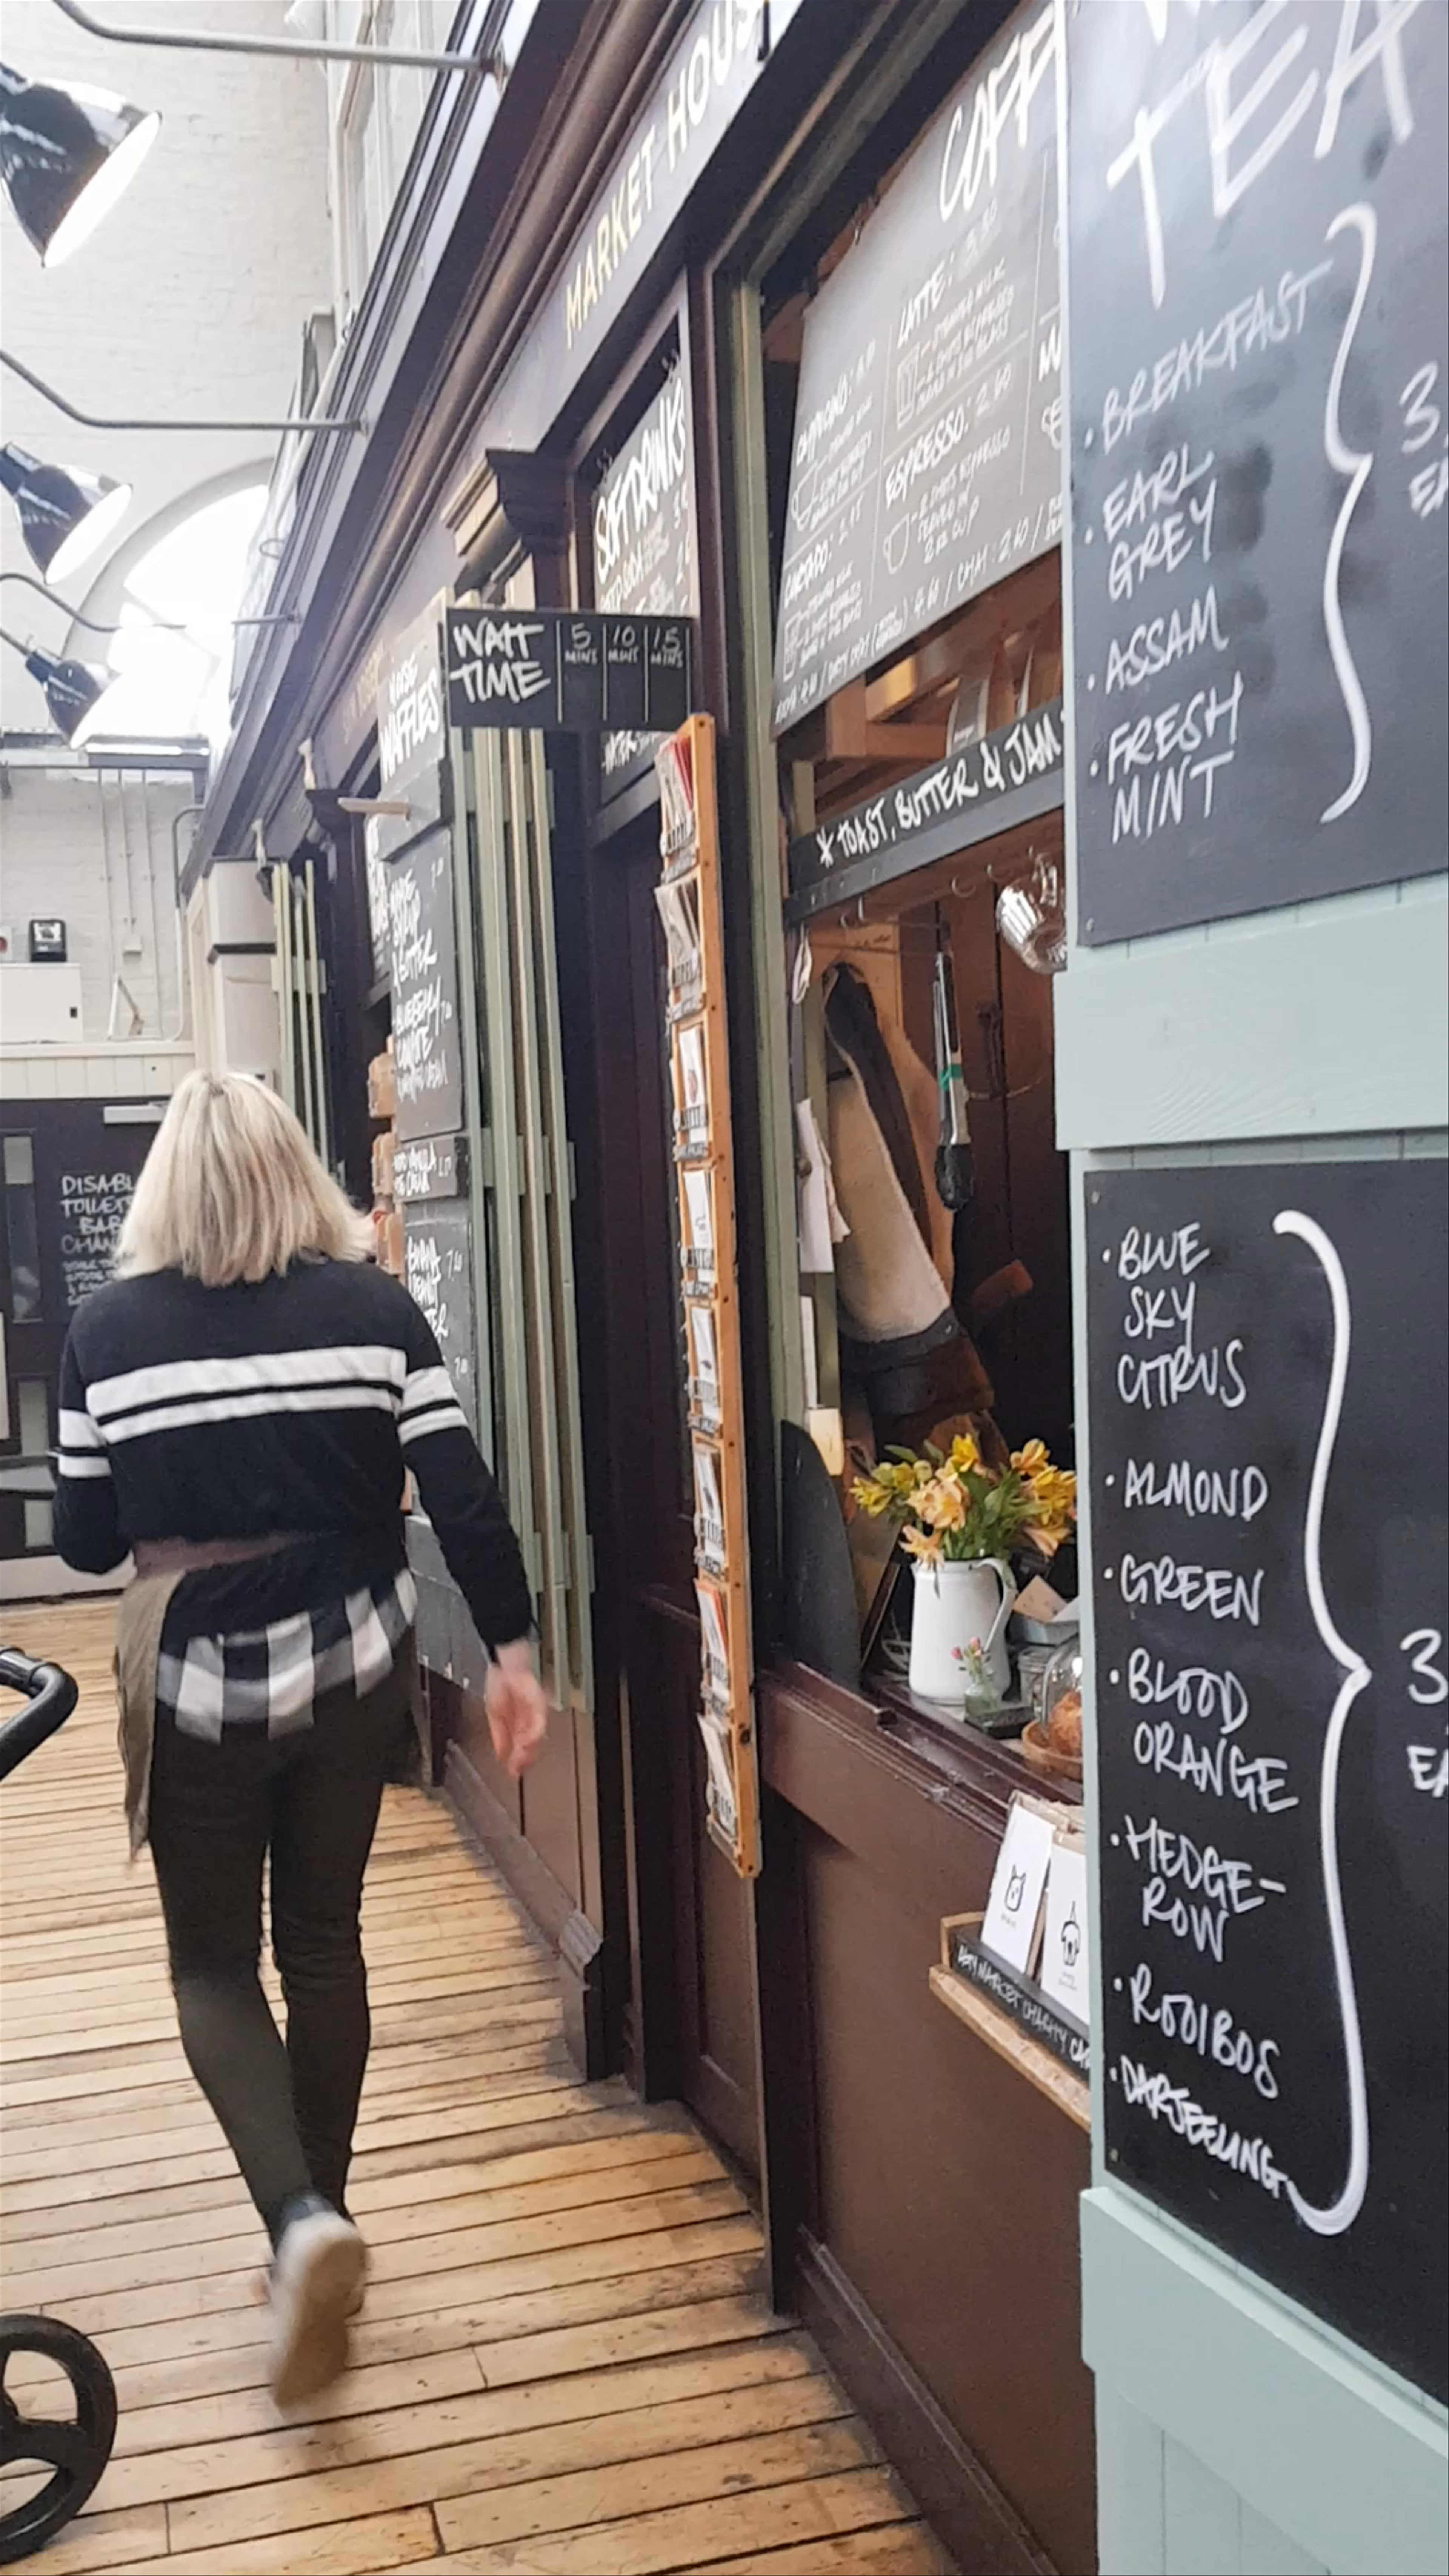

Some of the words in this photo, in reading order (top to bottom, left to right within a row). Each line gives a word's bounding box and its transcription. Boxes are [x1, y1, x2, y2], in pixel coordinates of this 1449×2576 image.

[940, 5, 1056, 222] COFF
[1106, 0, 1423, 309] TEA
[565, 124, 655, 349] MARKET
[1103, 259, 1334, 455] BREAKFAST
[594, 457, 635, 584] SOFT
[632, 377, 685, 531] DRINKS
[952, 495, 980, 540] CUP
[1103, 442, 1214, 545] EARL
[1108, 478, 1217, 601] GREY
[454, 617, 544, 659] WAIT
[565, 648, 597, 665] MINS
[571, 622, 591, 650] 5
[608, 646, 639, 664] MINS
[613, 624, 635, 648] 10
[651, 648, 683, 668] MINS
[654, 626, 680, 652] 15
[1105, 583, 1229, 694] ASSAM
[449, 659, 551, 703] TIME
[379, 667, 440, 783] WAFFLES
[1108, 670, 1244, 785] FRESH
[894, 758, 980, 830] BUTTER
[980, 741, 1006, 792] &
[1004, 712, 1062, 786] JAM
[1112, 750, 1235, 845] MINT
[62, 1173, 133, 1195] DISABL
[62, 1234, 115, 1255] CHAN
[78, 1215, 122, 1235] BAB
[1117, 1222, 1211, 1280] BLUE
[1125, 1281, 1195, 1349] SKY
[1117, 1339, 1246, 1410] CITRUS
[1124, 1459, 1269, 1522] ALMOND
[1120, 1553, 1265, 1626] GREEN
[1128, 1646, 1249, 1735] BLOOD
[1134, 1720, 1299, 1815] ORANGE
[1125, 1814, 1287, 1915] HEDGE-
[1142, 1879, 1229, 1963] ROW
[1069, 2037, 1090, 2070] CA
[1131, 1963, 1279, 2099] ROOIBOS
[1120, 2054, 1289, 2199] DARJEELING
